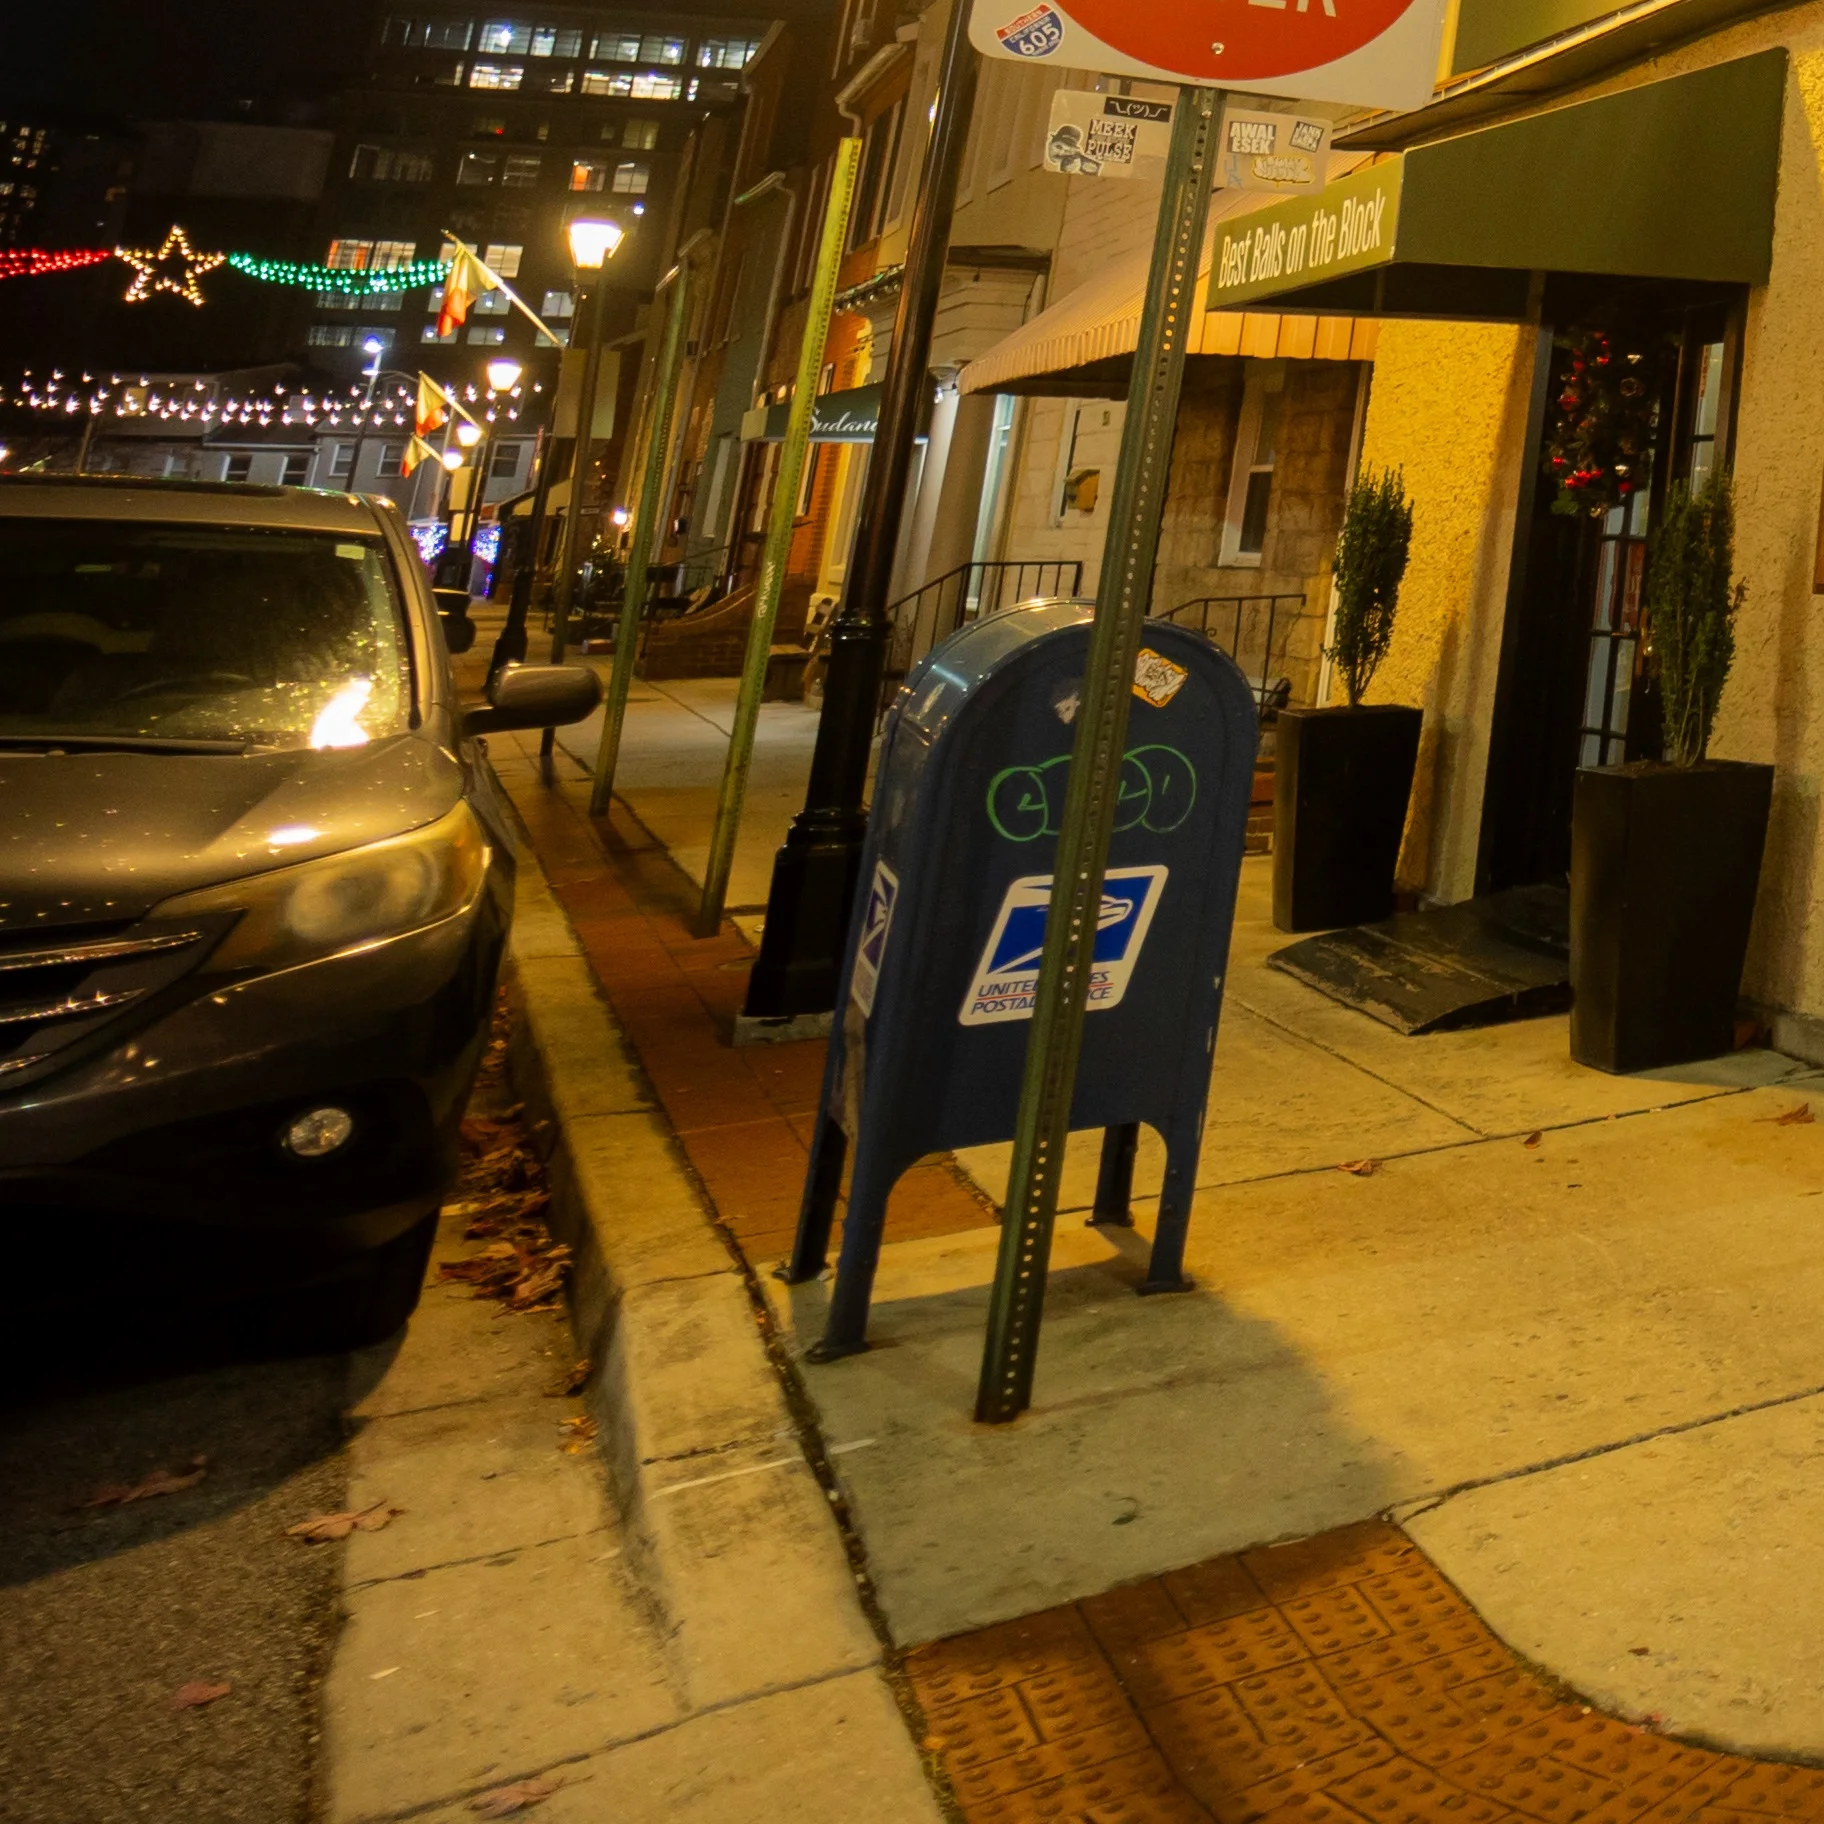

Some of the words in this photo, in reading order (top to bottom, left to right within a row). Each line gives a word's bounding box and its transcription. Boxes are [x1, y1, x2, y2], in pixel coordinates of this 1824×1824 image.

[1019, 23, 1060, 55] 605
[1090, 119, 1137, 140] MEEK
[1230, 122, 1275, 140] AWAL
[1084, 139, 1133, 162] PULSE
[1231, 137, 1271, 154] ESEK
[1218, 230, 1252, 288] Best
[1250, 222, 1286, 283] Balls
[1286, 224, 1307, 275] on
[1309, 208, 1337, 267] the
[1337, 187, 1386, 260] Block
